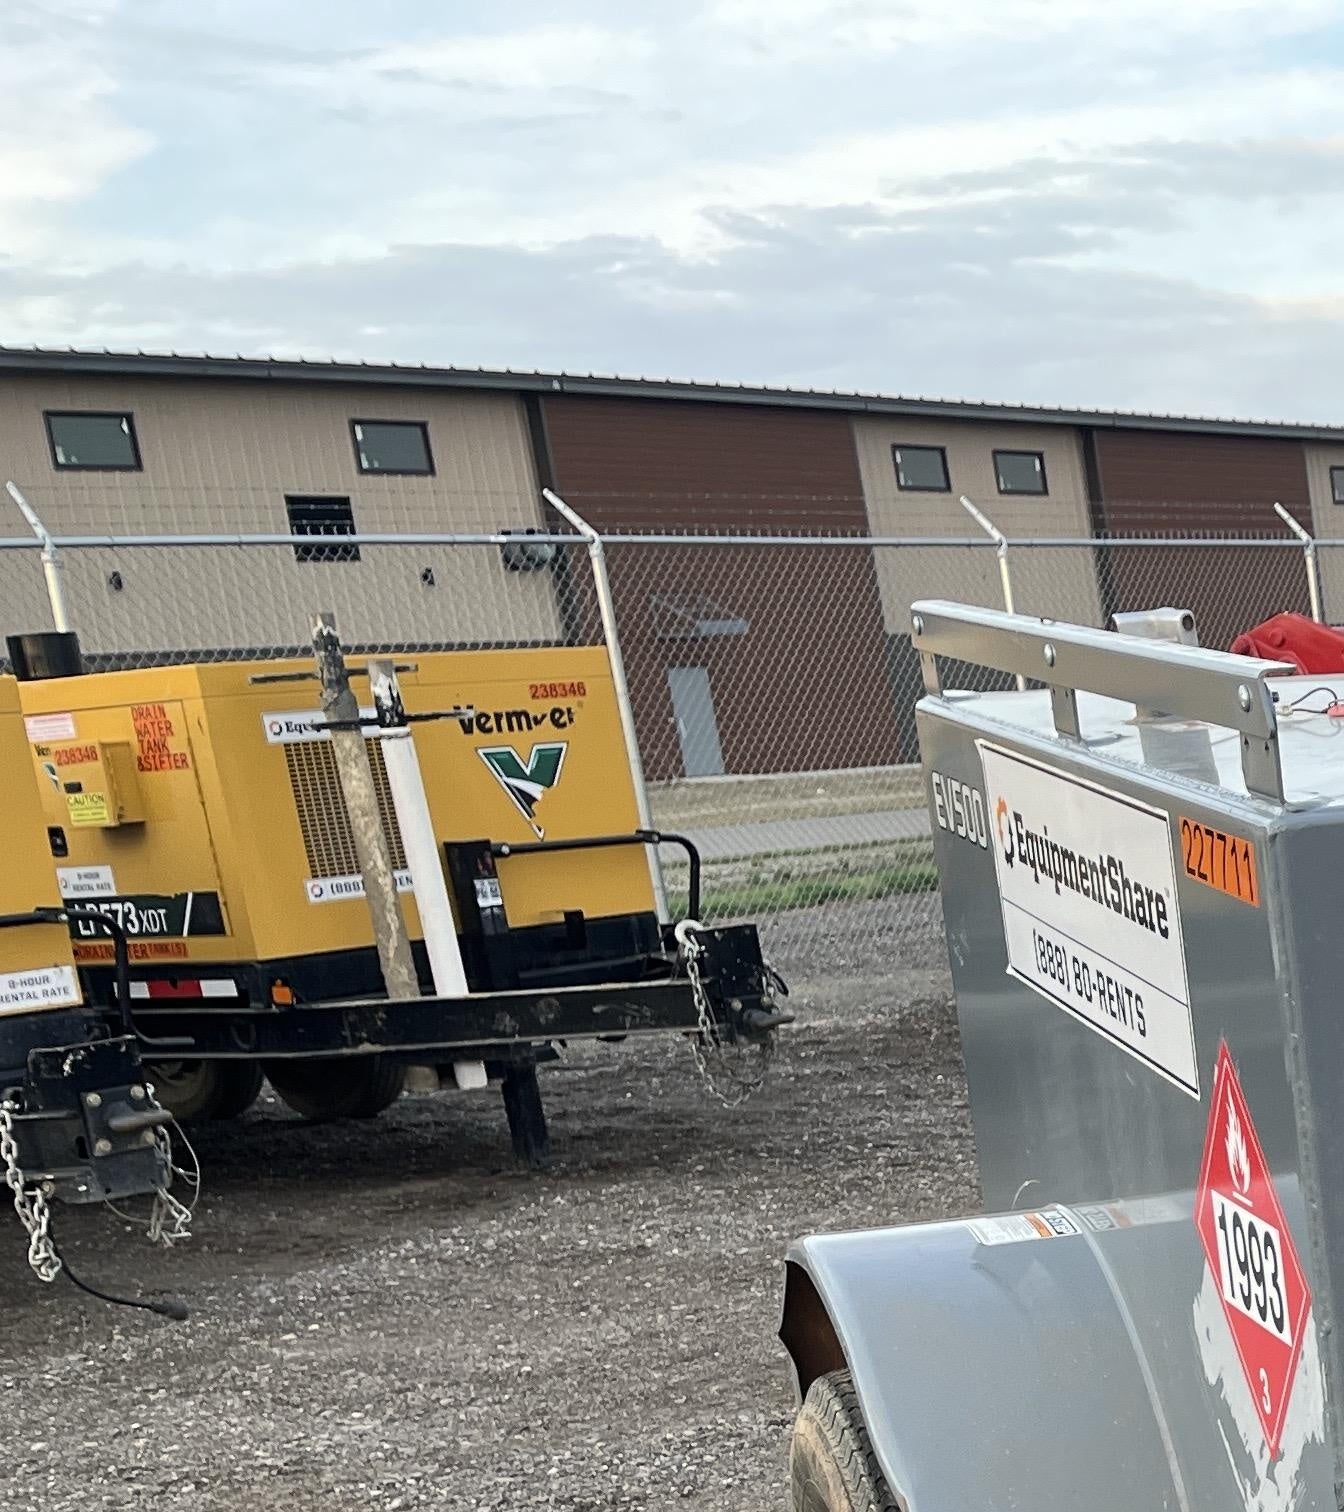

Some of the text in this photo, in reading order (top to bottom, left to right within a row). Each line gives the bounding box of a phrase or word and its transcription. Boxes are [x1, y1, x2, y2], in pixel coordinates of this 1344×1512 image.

[529, 681, 587, 700] 238346
[131, 703, 166, 721] DRAIN
[55, 745, 99, 767] 238346
[138, 738, 170, 755] TANK
[931, 770, 988, 850] EV500
[1180, 818, 1255, 902] 227711
[1012, 811, 1170, 939] EquipmentShare
[141, 908, 169, 934] XDT
[8, 975, 50, 989] 8-HOUR
[42, 985, 70, 998] RATE
[1033, 928, 1148, 1038] (888) 80-RENTS
[1218, 1201, 1286, 1334] 1993
[1259, 1367, 1273, 1415] 3
